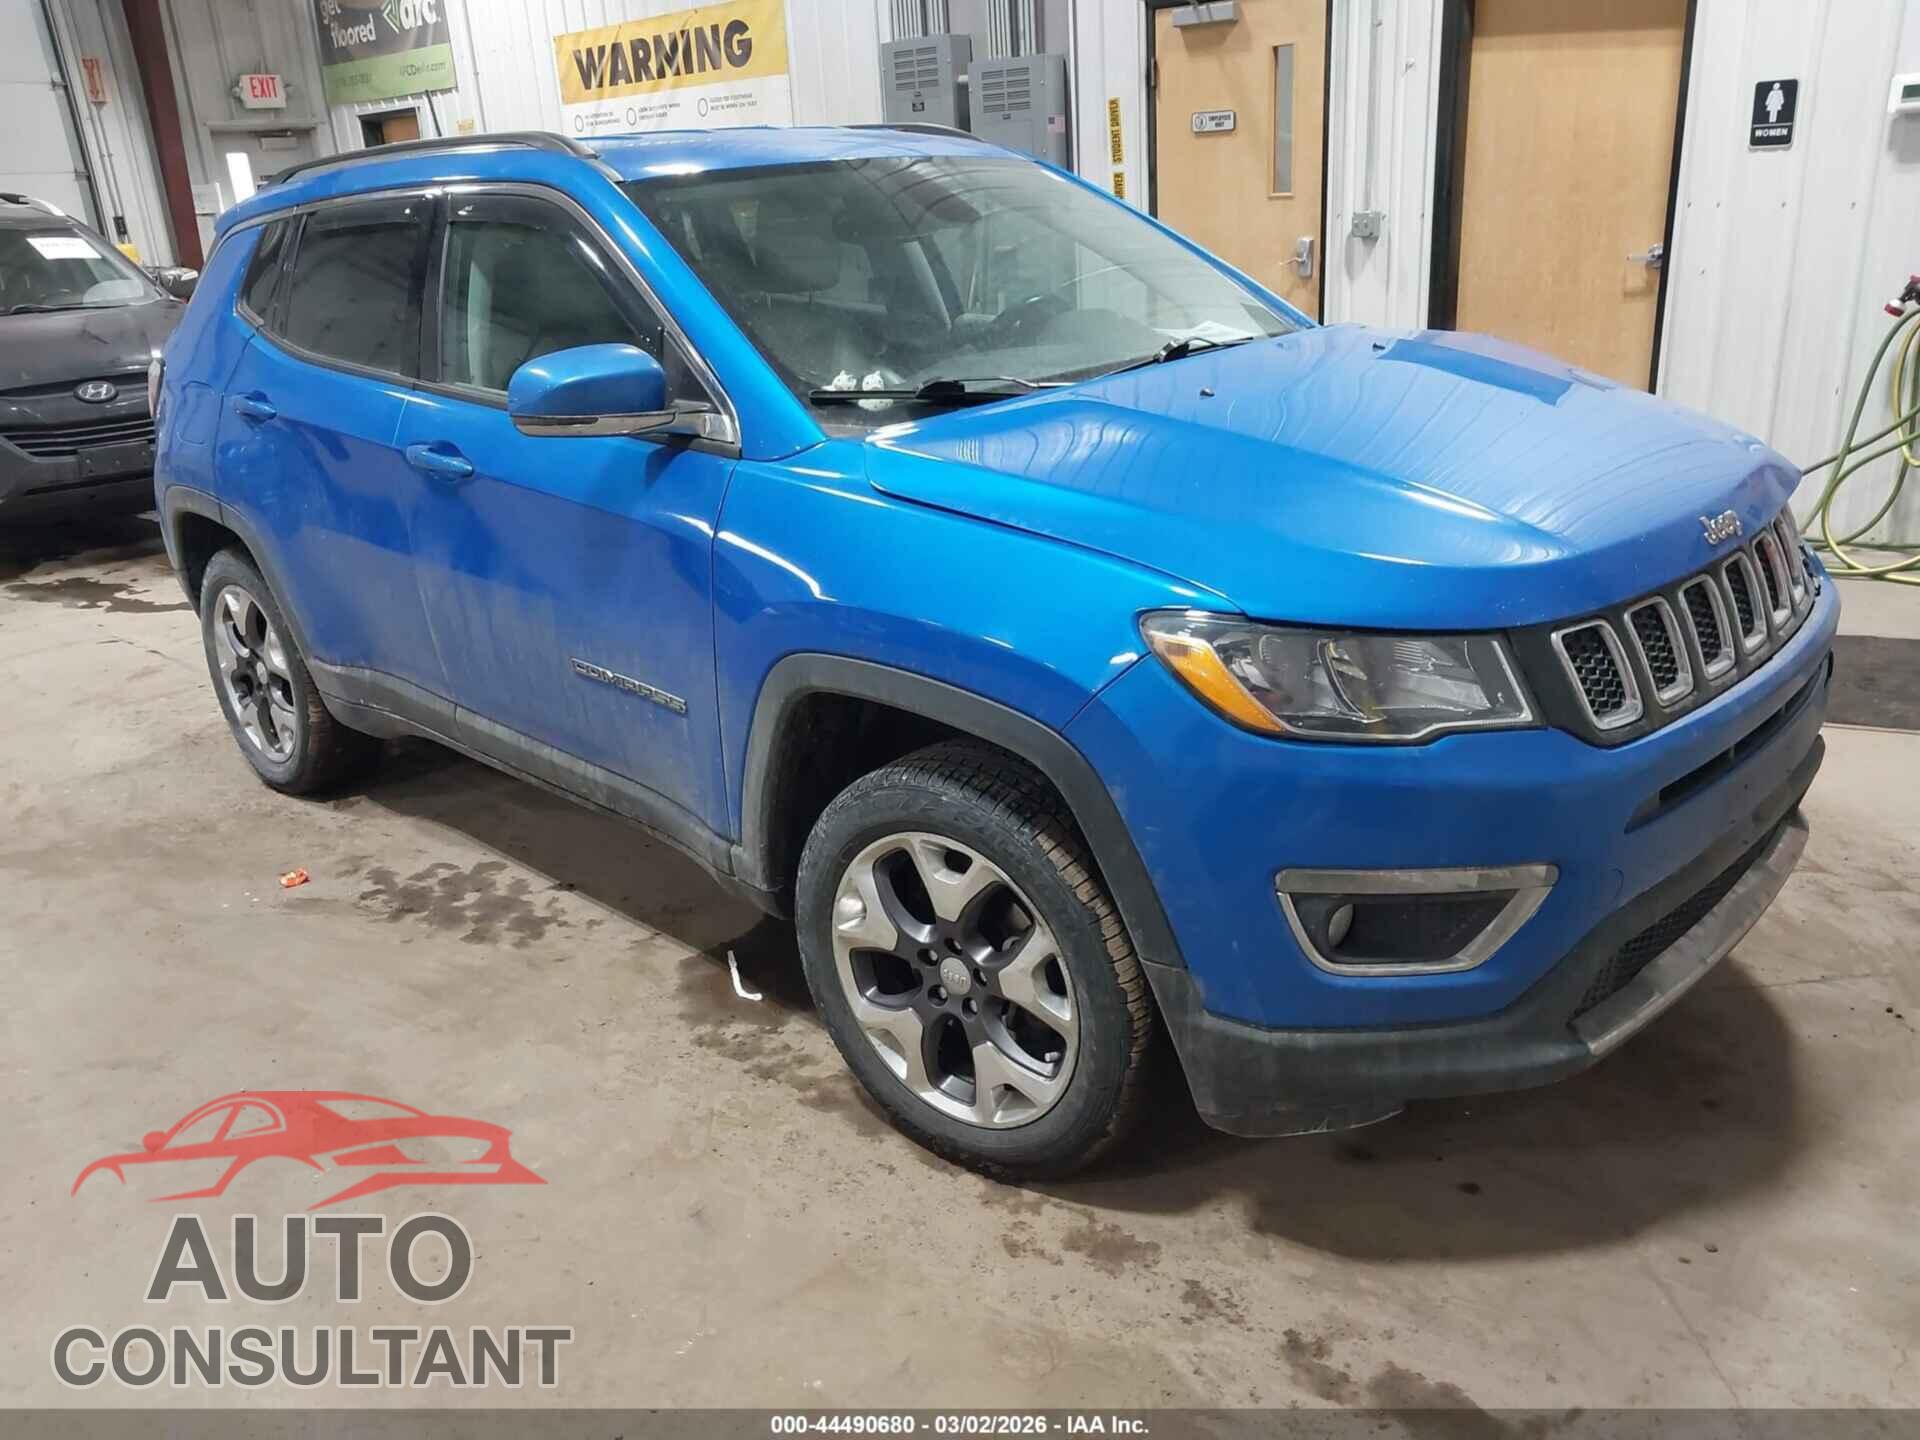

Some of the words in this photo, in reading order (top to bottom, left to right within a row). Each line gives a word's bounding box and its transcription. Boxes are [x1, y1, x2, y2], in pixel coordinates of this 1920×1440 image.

[573, 19, 753, 91] WARNING
[249, 76, 277, 98] EXIT
[1111, 129, 1122, 163] STUDENT
[1754, 128, 1788, 137] WOMEN
[1699, 510, 1742, 545] Jeep
